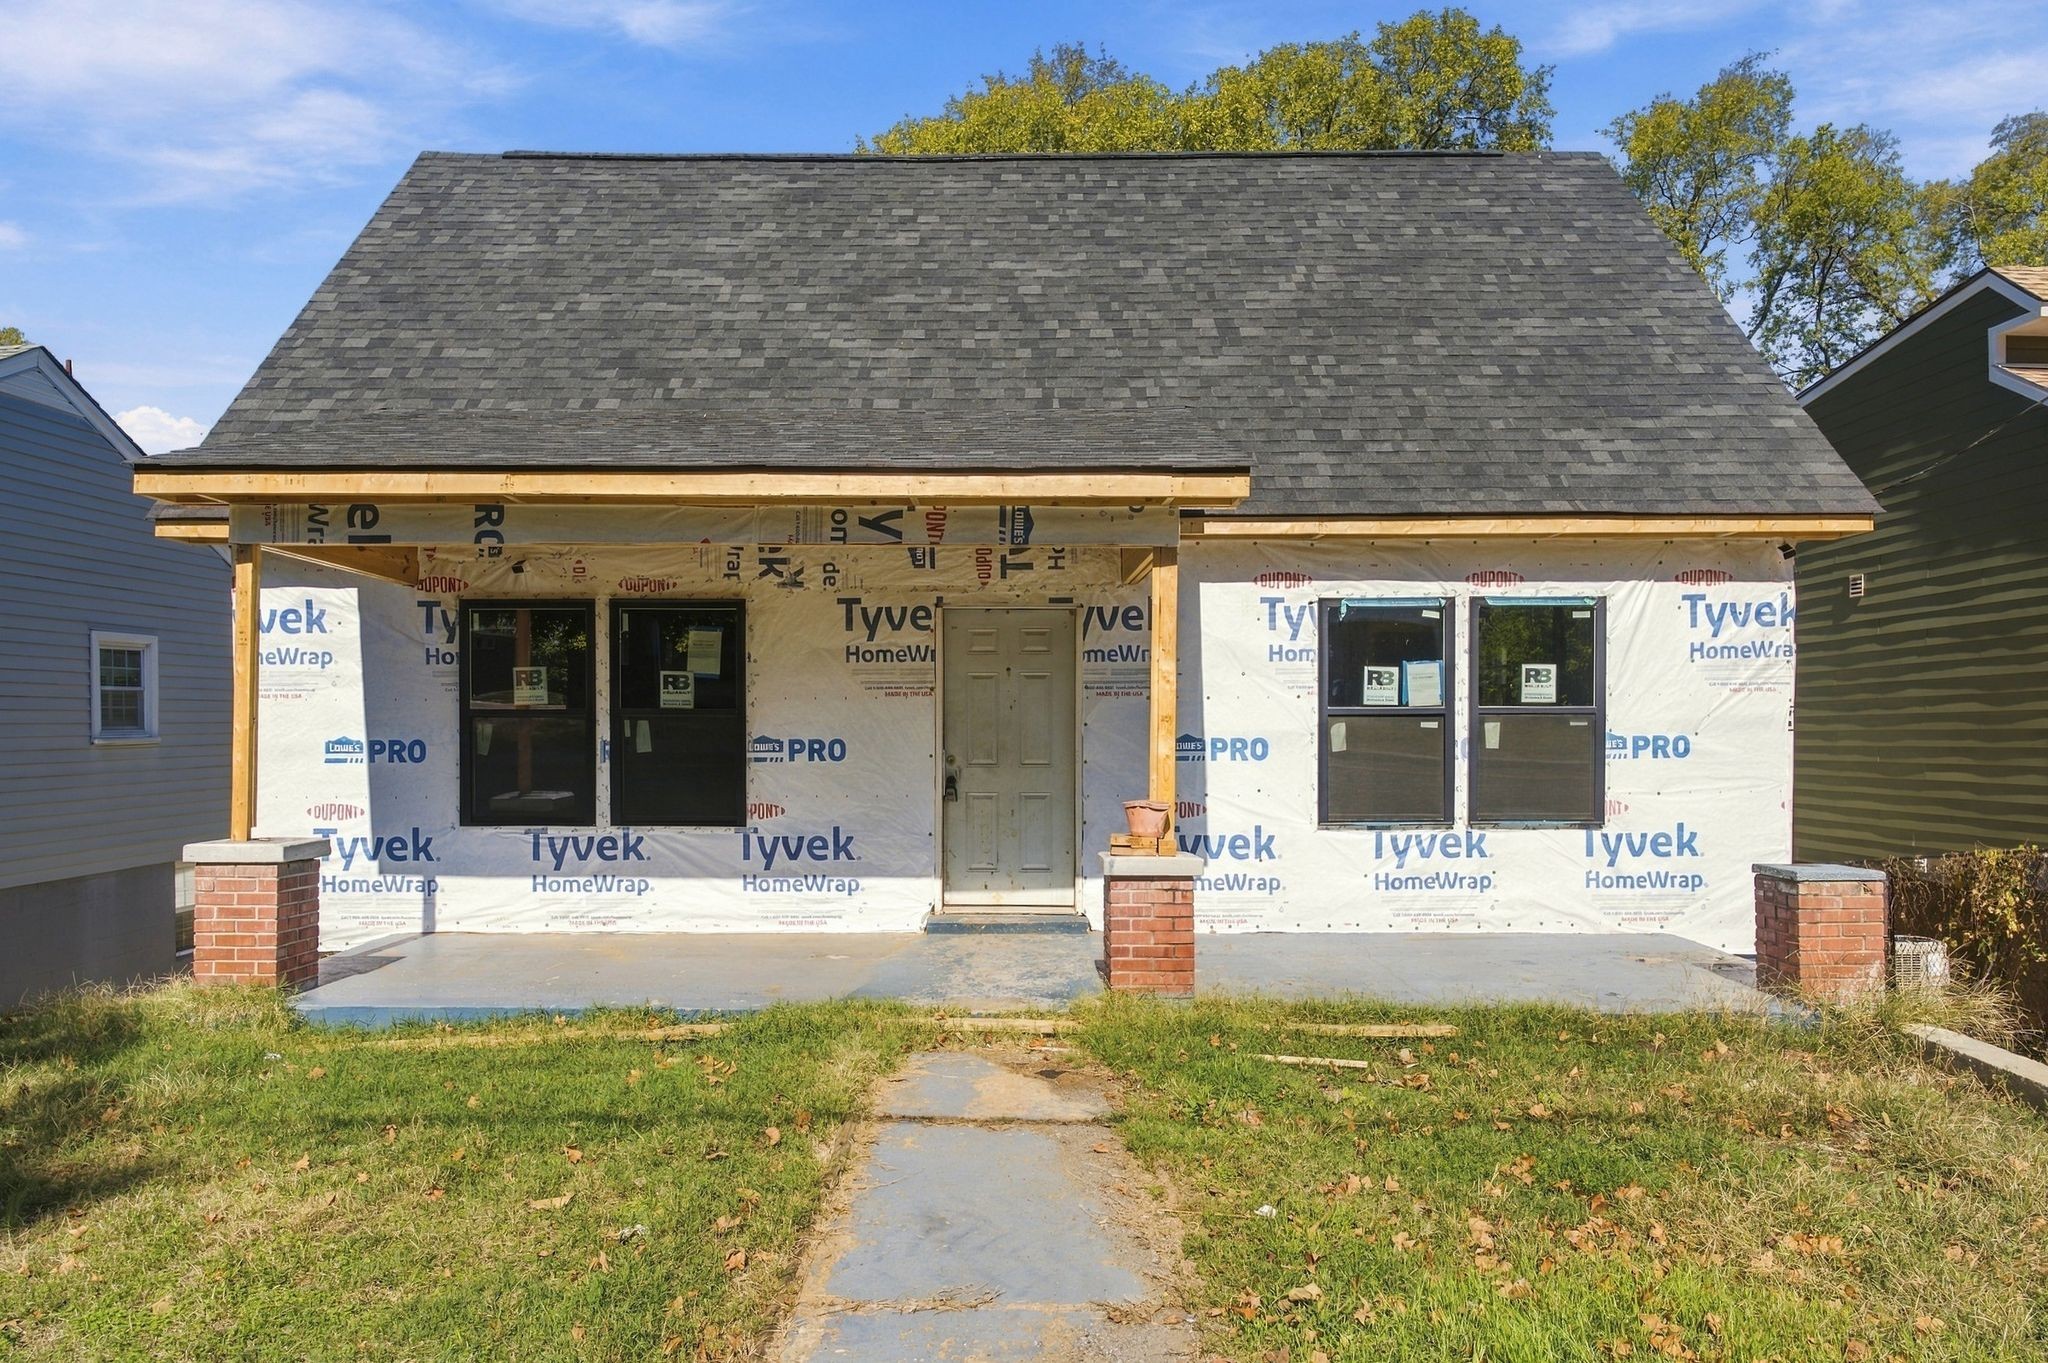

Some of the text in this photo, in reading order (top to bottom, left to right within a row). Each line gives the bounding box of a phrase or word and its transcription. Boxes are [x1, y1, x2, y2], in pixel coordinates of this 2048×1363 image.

[1260, 572, 1306, 588] DUPONT
[1472, 571, 1518, 588] DUPONT
[1681, 569, 1727, 586] DUPONT
[258, 599, 327, 635] vek
[837, 597, 943, 641] Tyve
[1690, 640, 1796, 660] HomeWra
[663, 675, 691, 690] RB
[1367, 670, 1395, 686] RB
[1524, 667, 1552, 683] RB
[369, 739, 427, 763] PRO
[788, 738, 846, 762] PRO
[1210, 737, 1269, 761] PRO
[1632, 735, 1691, 759] PRO
[314, 803, 358, 821] DUPONT
[747, 802, 780, 820] PONT
[313, 827, 434, 871] Tyvek
[525, 827, 645, 871] Tyvek
[734, 826, 855, 871] Tyvek
[1175, 825, 1276, 860] yvek
[322, 875, 439, 897] HomeWrap
[532, 875, 649, 896] HomeWrap
[743, 874, 860, 896] HomeWrap
[1193, 873, 1281, 895] meWrap
[1374, 872, 1492, 893] HomeWrap
[1585, 870, 1703, 892] HomeWrap
